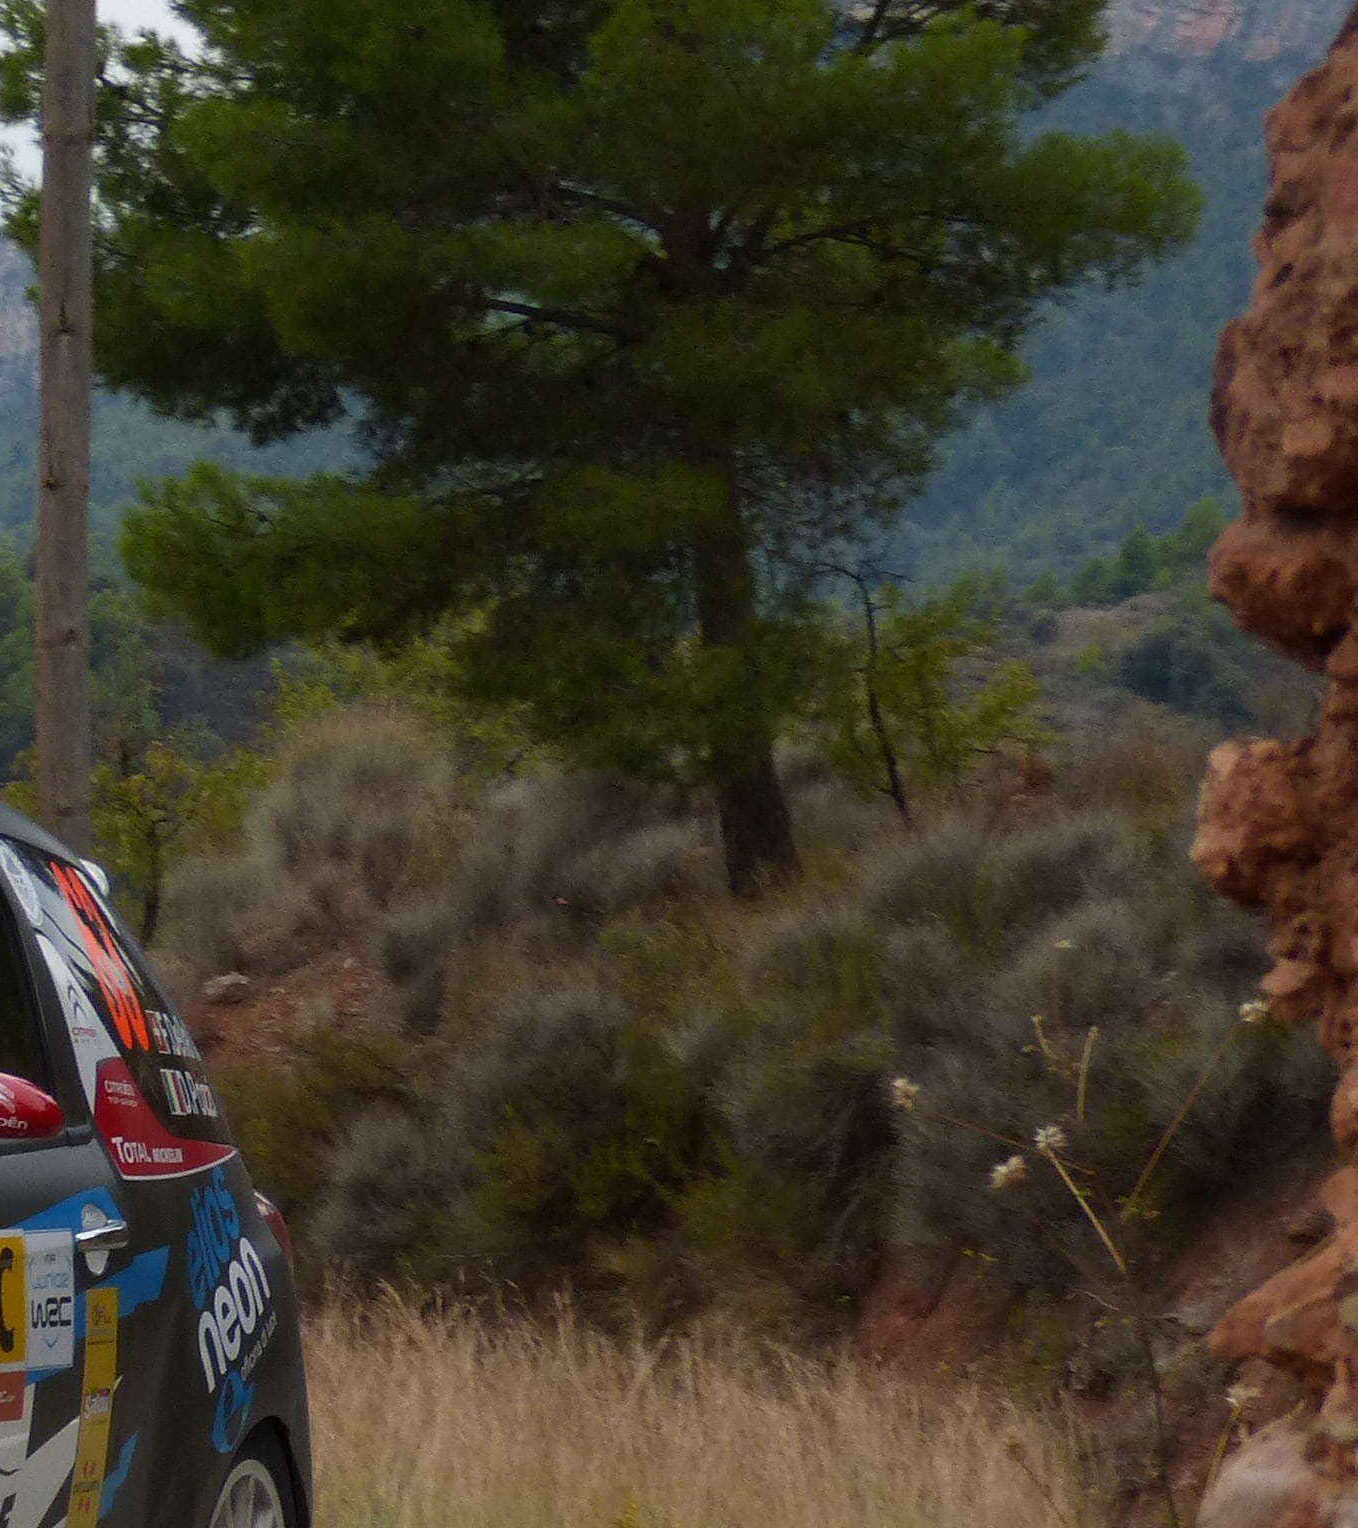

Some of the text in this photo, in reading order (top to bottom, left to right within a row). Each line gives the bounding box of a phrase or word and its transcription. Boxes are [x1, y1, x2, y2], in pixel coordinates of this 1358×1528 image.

[111, 1136, 152, 1164] TOTAL
[31, 1296, 72, 1330] WRC
[198, 1236, 271, 1394] neon
